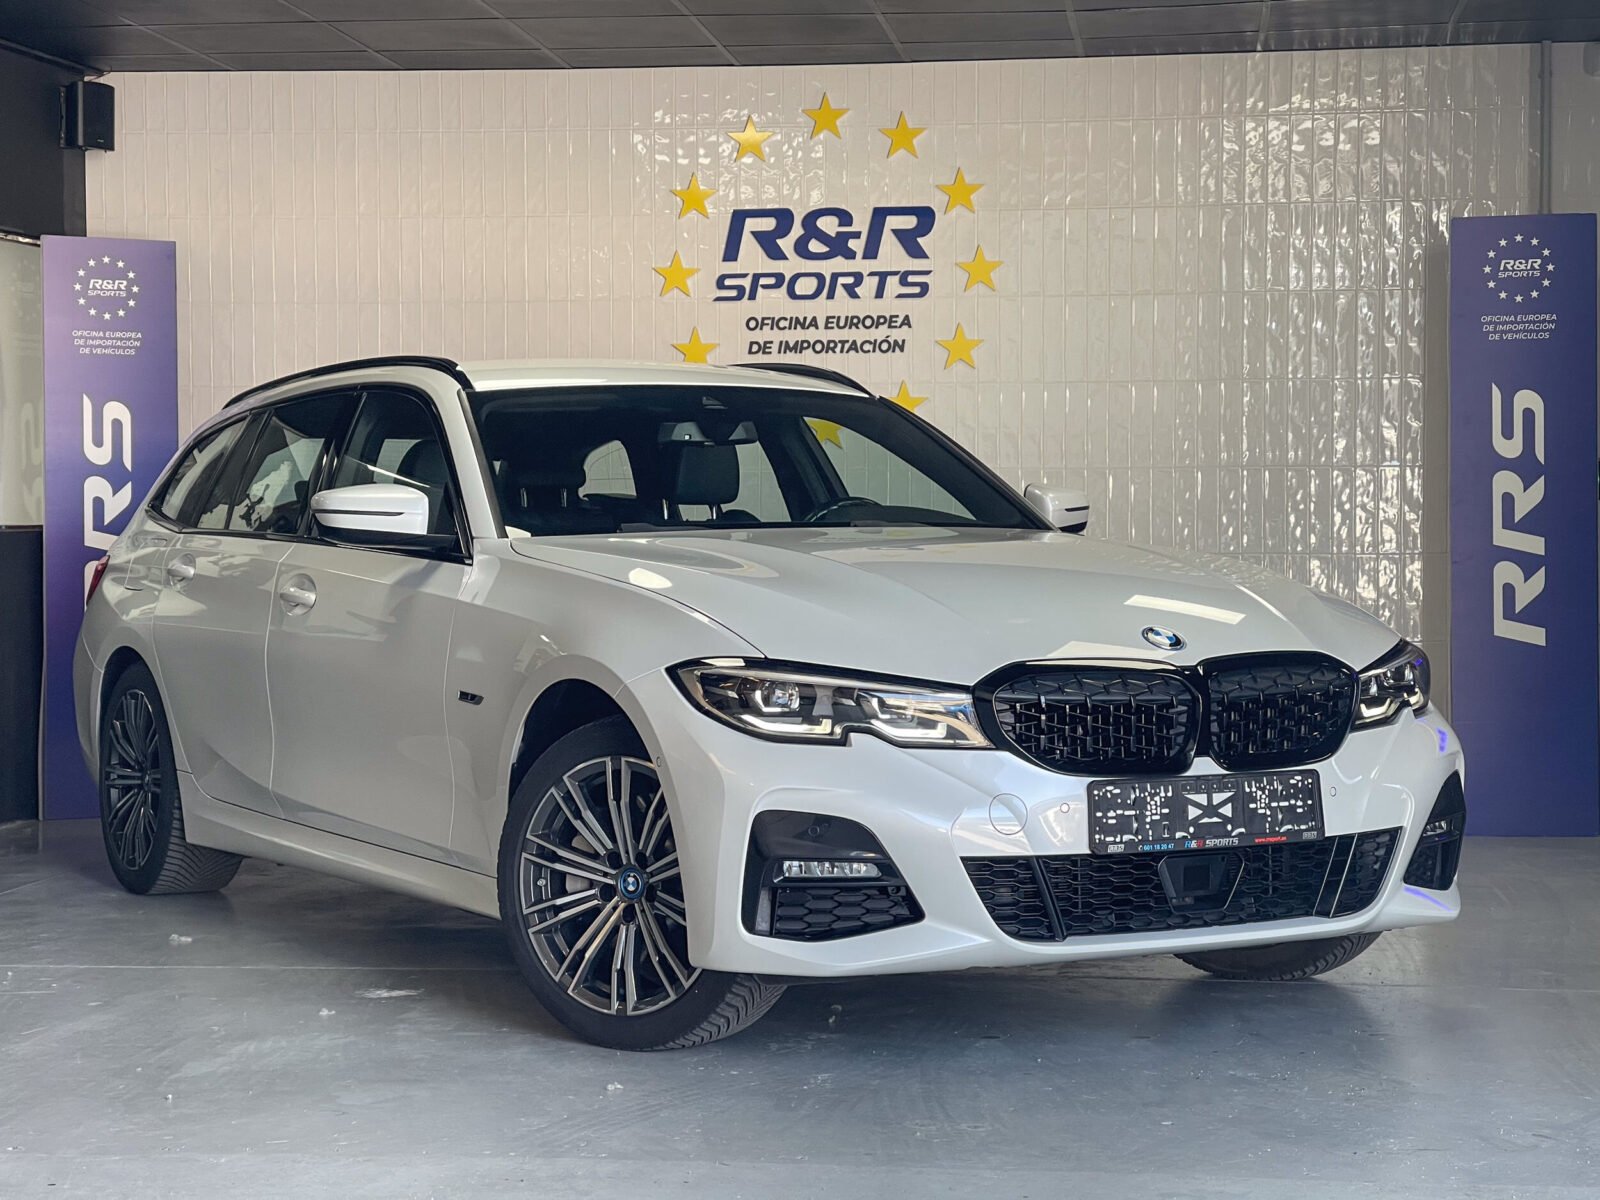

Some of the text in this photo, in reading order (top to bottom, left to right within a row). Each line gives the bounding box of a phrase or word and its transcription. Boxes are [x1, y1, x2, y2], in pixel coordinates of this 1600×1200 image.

[722, 205, 936, 263] R&R
[1500, 259, 1541, 270] R&R
[1498, 270, 1541, 278] SPORTS
[89, 279, 127, 290] R&R
[712, 270, 933, 302] SPORTS
[745, 314, 912, 331] OFICINA EUROPEA
[1496, 322, 1555, 331] IMPORTACIÓN
[1502, 331, 1550, 340] VEHÍCULOS
[87, 339, 140, 347] IMPORTACIÓN
[748, 335, 905, 355] DE IMPORTACIÓN
[92, 346, 136, 355] VEHÍCULOS
[1492, 382, 1546, 647] RRS
[1184, 837, 1239, 849] R&R SPORTS
